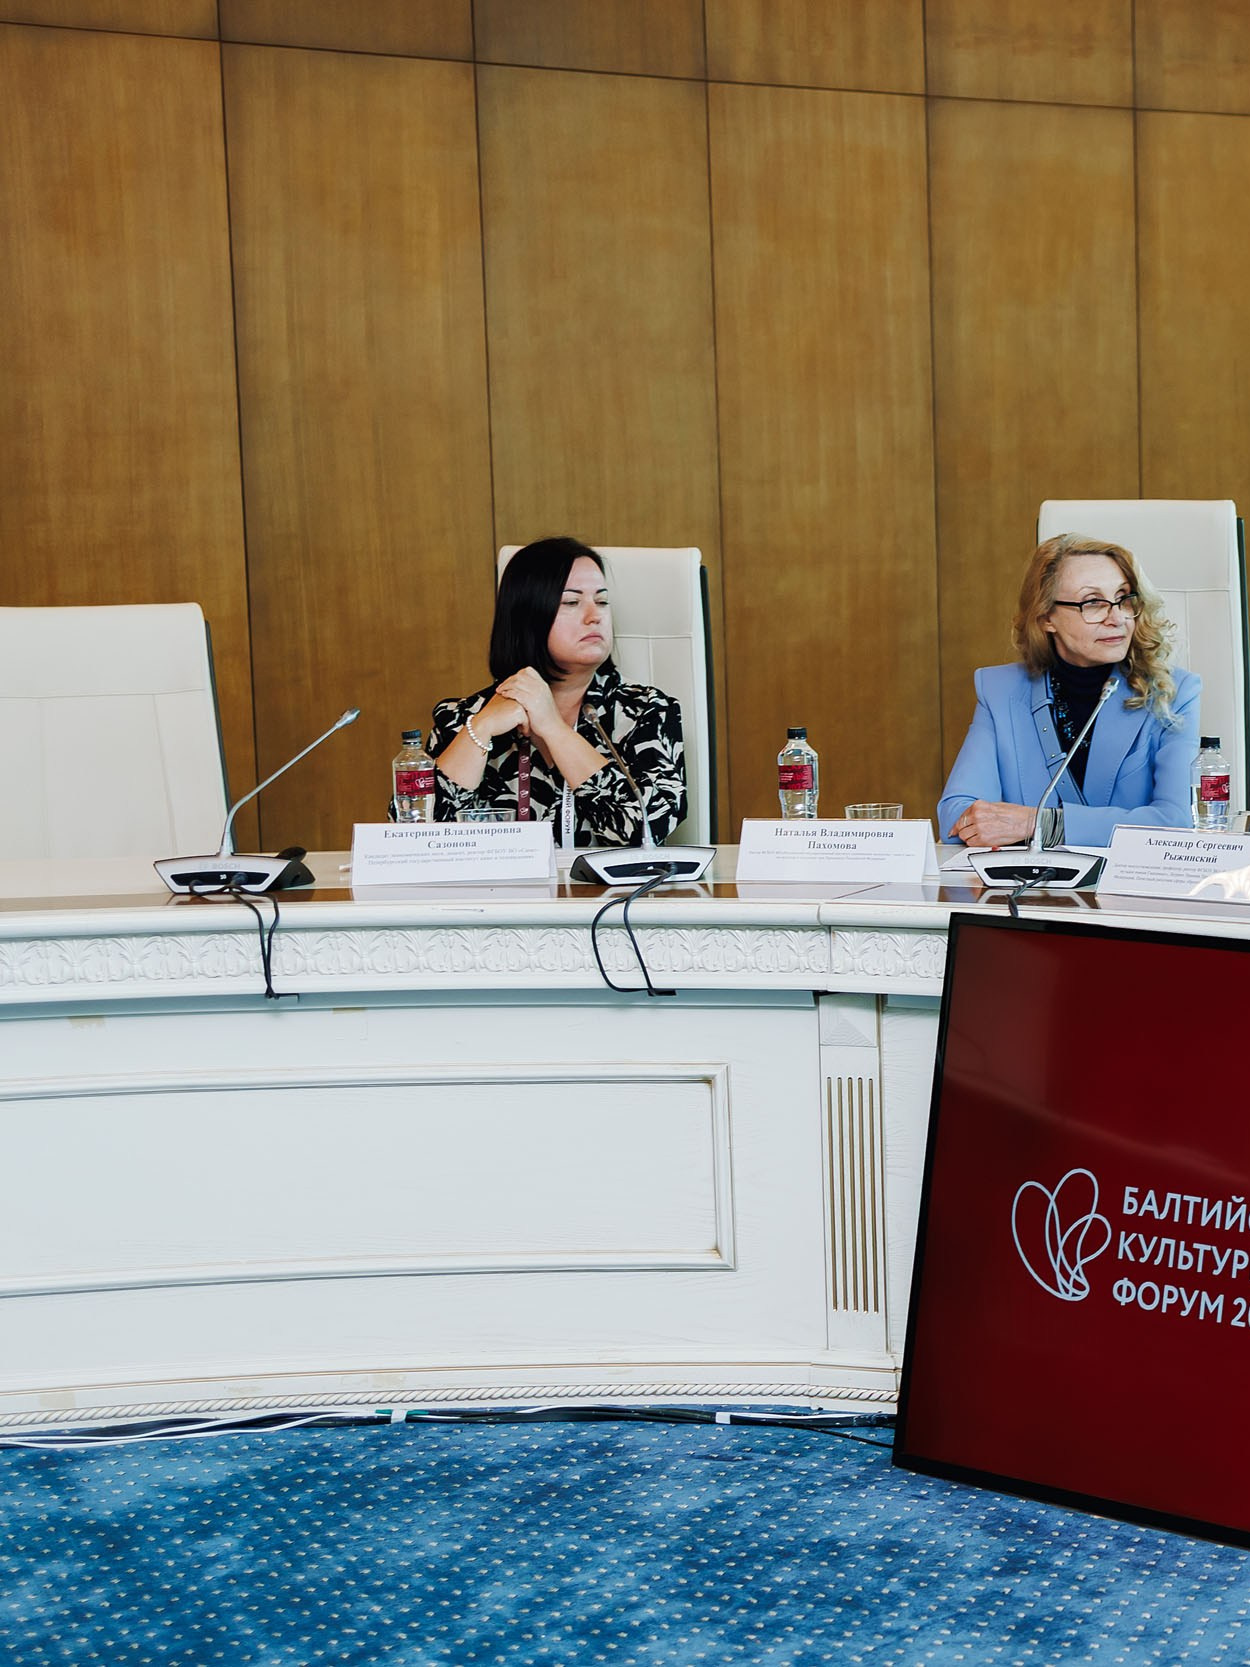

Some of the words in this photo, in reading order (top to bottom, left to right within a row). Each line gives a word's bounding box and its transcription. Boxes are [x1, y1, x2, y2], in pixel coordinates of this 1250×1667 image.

[384, 829, 441, 841] Екатерина
[444, 826, 522, 838] Владимировна
[774, 828, 817, 837] Наталья
[820, 828, 894, 840] Владимировна
[427, 840, 477, 849] Сазонова
[808, 840, 857, 850] Пахомова
[1145, 838, 1194, 849] Александр
[1196, 839, 1243, 851] Сергеевич
[1164, 852, 1218, 863] Рыжинский
[1112, 1277, 1225, 1323] ФОРУМ
